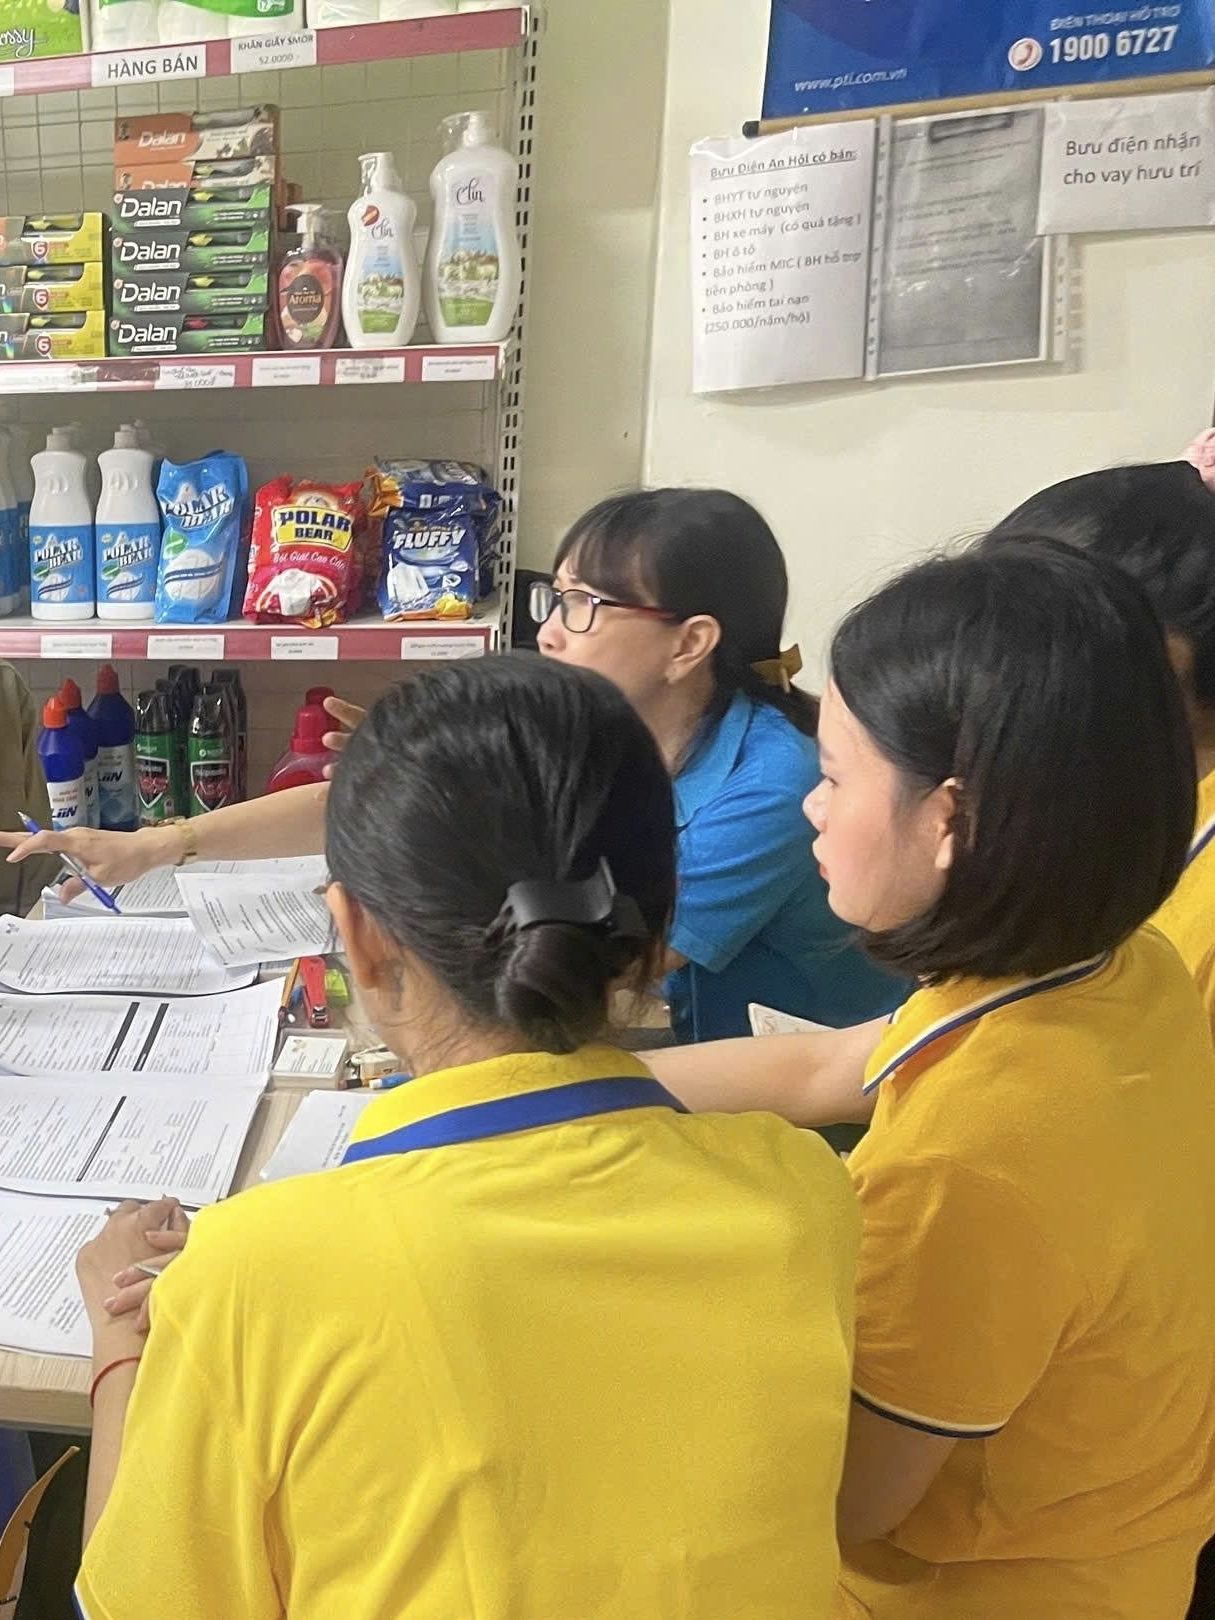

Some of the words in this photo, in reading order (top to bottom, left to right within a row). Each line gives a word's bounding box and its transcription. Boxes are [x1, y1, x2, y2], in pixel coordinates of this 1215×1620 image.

[1049, 33, 1110, 63] 1900
[1116, 25, 1178, 57] 6727
[108, 58, 157, 79] HÀNG
[163, 53, 198, 73] BÁN
[138, 130, 187, 149] Dalan
[1066, 140, 1103, 156] Bưu
[1108, 136, 1148, 155] điện
[1154, 131, 1200, 152] nhận
[769, 158, 785, 169] An
[812, 153, 826, 164] có
[1063, 168, 1096, 185] cho
[1101, 168, 1133, 185] vay
[1137, 164, 1174, 181] hưu
[1180, 160, 1202, 178] trí
[121, 197, 182, 219] Dalan
[714, 231, 730, 242] BH
[733, 230, 747, 239] xe
[749, 224, 775, 240] máy
[121, 239, 180, 262] Dalan
[714, 249, 729, 260] BH
[805, 255, 822, 267] BH
[36, 290, 47, 305] 6
[121, 281, 181, 303] Dalan
[117, 323, 178, 344] Dalan
[38, 337, 49, 353] 6
[164, 484, 230, 516] POLAR
[181, 499, 235, 528] BEAR
[279, 510, 351, 532] POLAR
[294, 527, 334, 541] BEAR
[392, 528, 467, 550] FLUFFY
[34, 538, 80, 562] POLAR
[103, 536, 152, 562] POLAR
